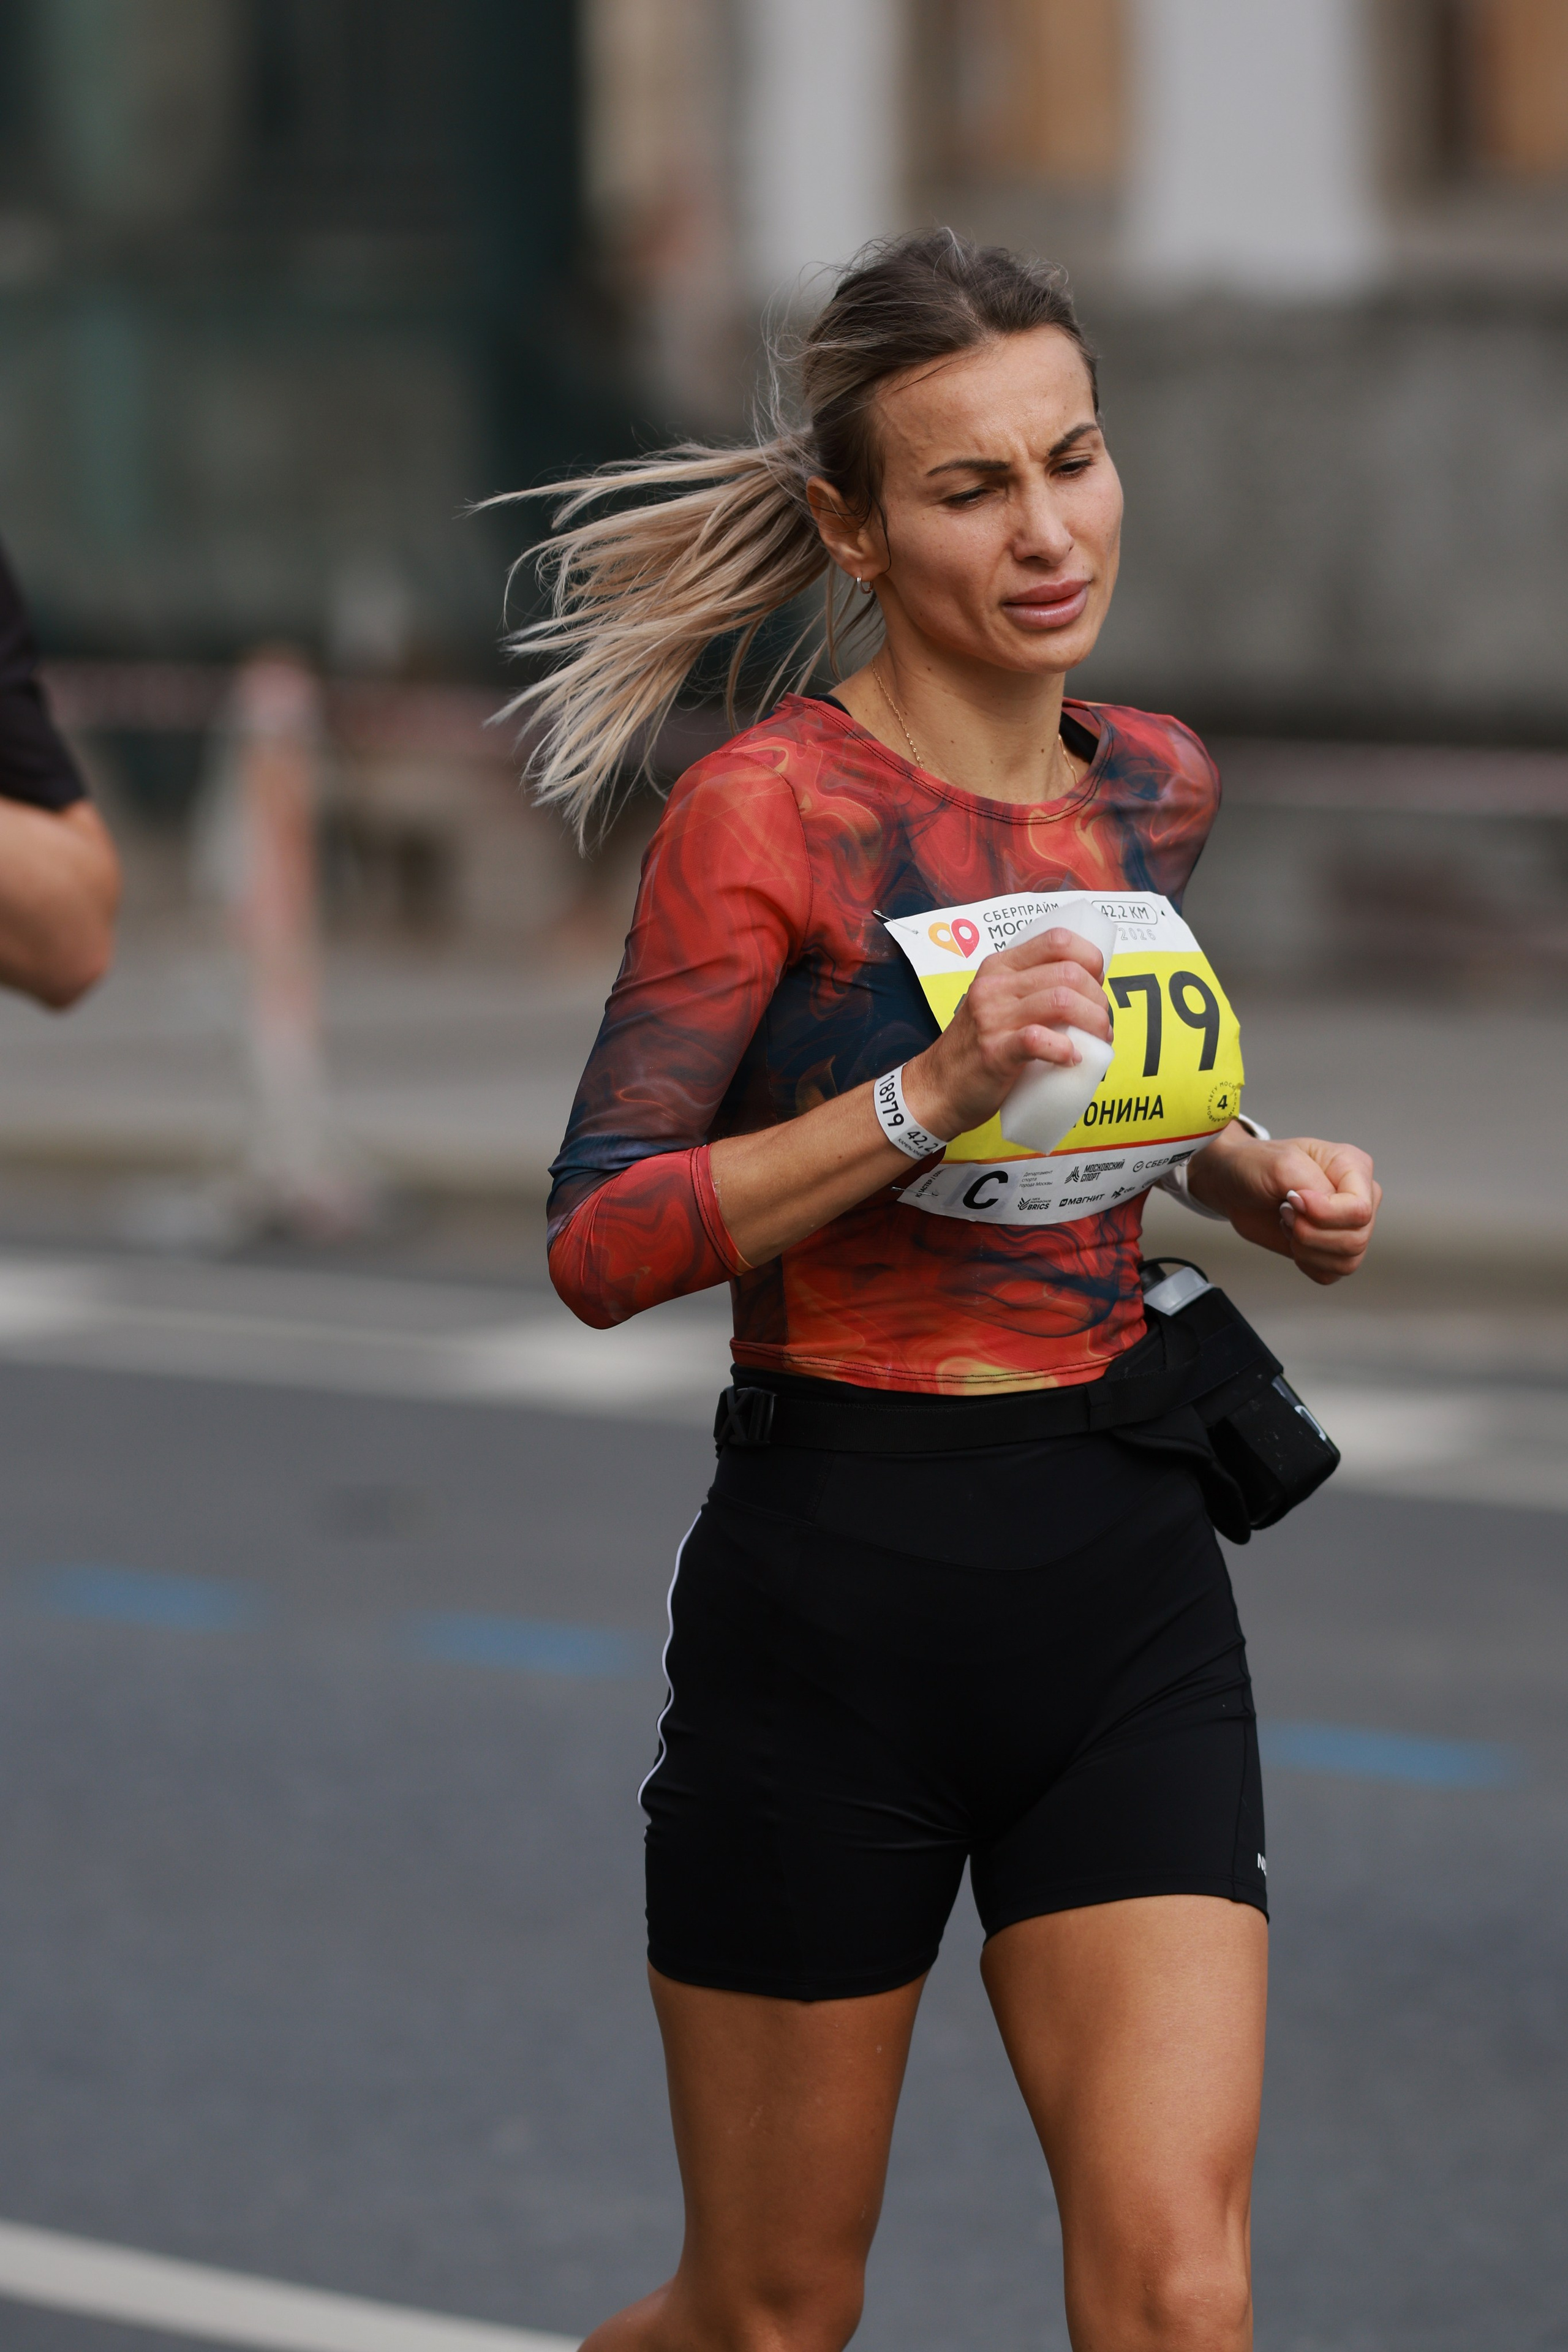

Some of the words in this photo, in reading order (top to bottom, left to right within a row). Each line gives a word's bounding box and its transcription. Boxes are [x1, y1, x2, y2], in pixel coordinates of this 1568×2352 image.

[1101, 905, 1128, 919] 42,2
[1129, 907, 1149, 919] КМ
[1118, 927, 1156, 940] 2026
[880, 1075, 904, 1126] 18979
[1217, 1095, 1227, 1110] 4
[1073, 1095, 1164, 1128] ОНИНА
[907, 1131, 938, 1152] 42,2
[1084, 1159, 1125, 1173] МОСКОВСКИЙ
[1145, 1158, 1169, 1169] СБЕР
[1080, 1172, 1101, 1182] СПОРТ
